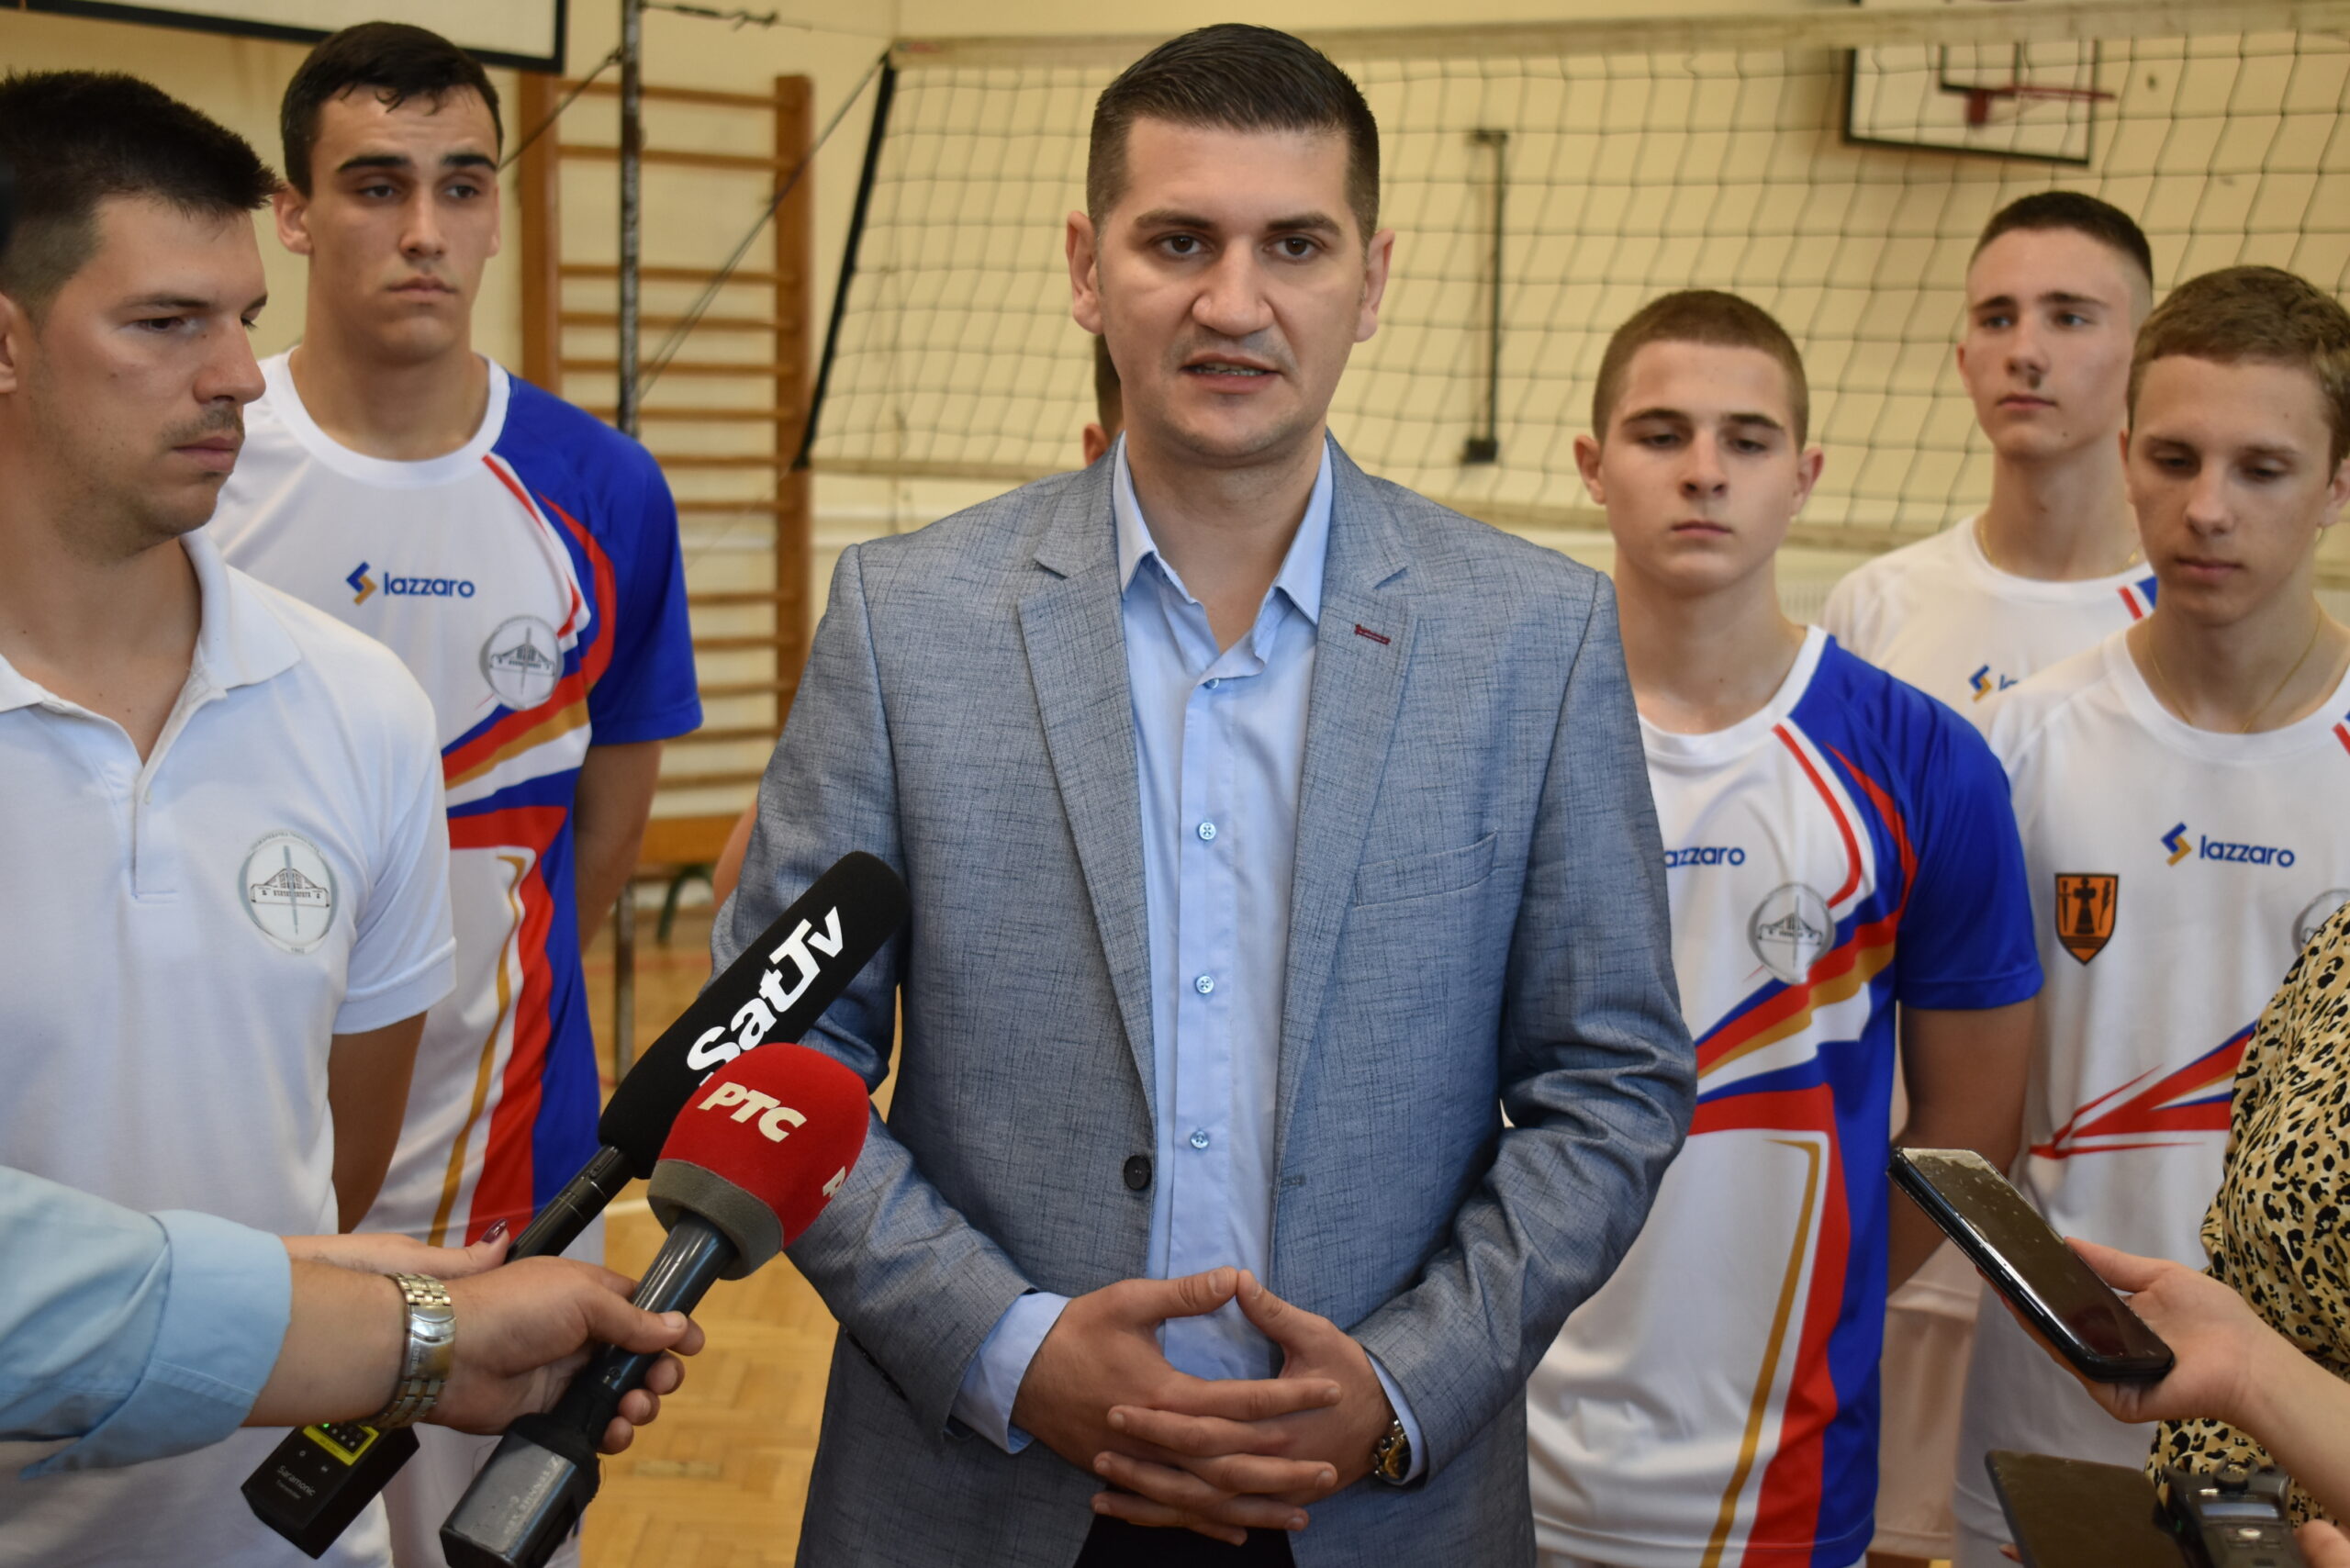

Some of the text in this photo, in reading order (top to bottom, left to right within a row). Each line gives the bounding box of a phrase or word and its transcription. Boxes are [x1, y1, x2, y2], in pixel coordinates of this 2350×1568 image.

[384, 572, 476, 598] lazzaro
[1664, 846, 1746, 868] azzaro
[2199, 834, 2295, 868] lazzaro
